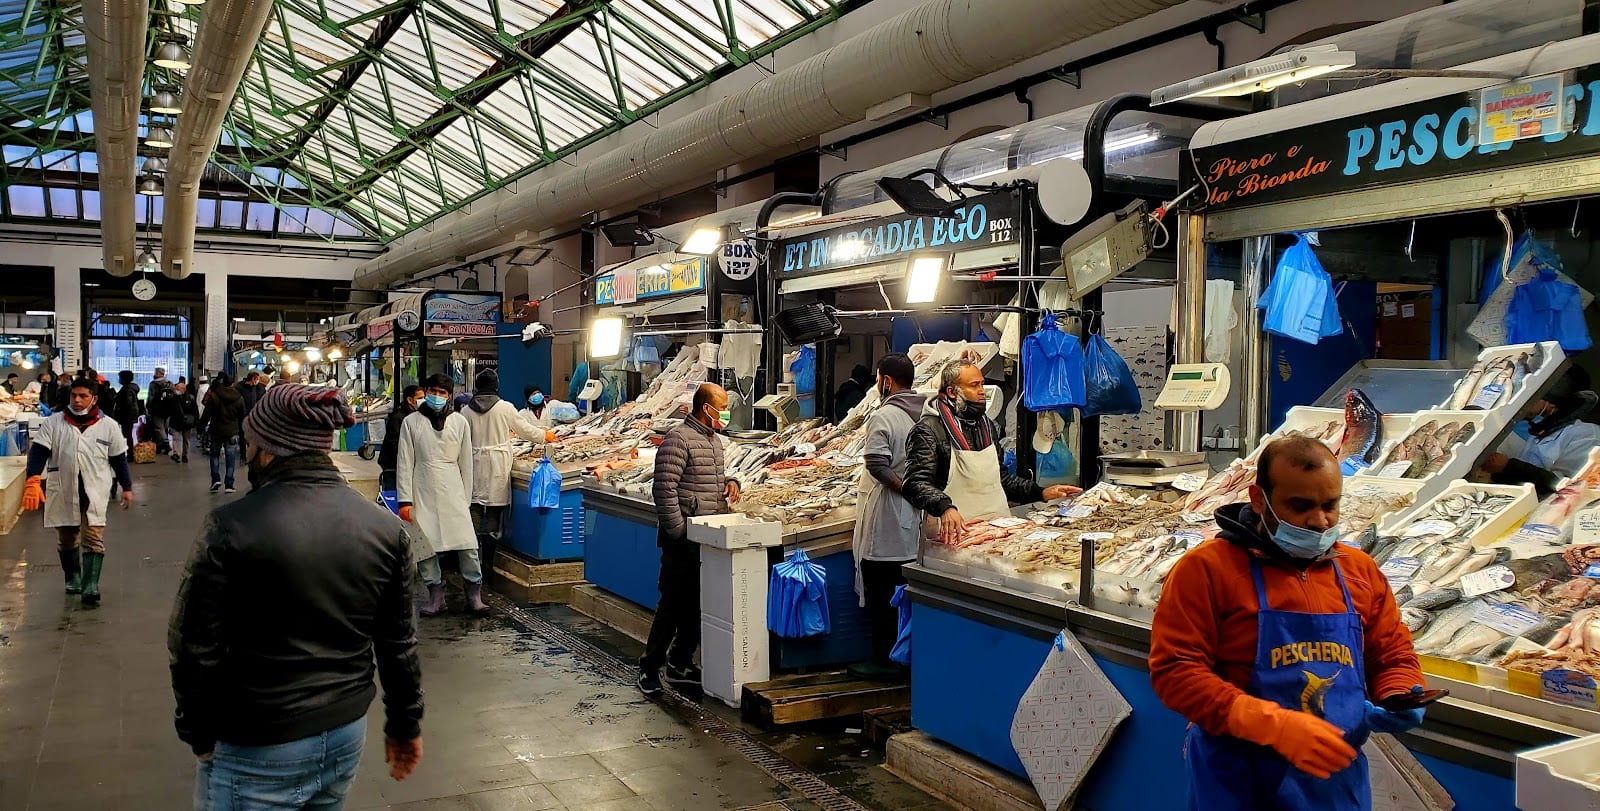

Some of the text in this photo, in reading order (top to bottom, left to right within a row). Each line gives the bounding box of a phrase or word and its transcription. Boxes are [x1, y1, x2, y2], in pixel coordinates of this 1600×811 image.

[1207, 144, 1303, 183] Piero e
[1209, 156, 1334, 206] la Bionda
[783, 240, 807, 271] ET
[809, 237, 830, 266] IN
[930, 203, 987, 247] EGO
[989, 217, 1013, 231] BOX
[990, 230, 1011, 244] 112
[723, 244, 753, 259] BOX
[726, 261, 751, 275] 127
[740, 568, 748, 609] NORTHERN
[1271, 641, 1354, 669] PESCHERIA
